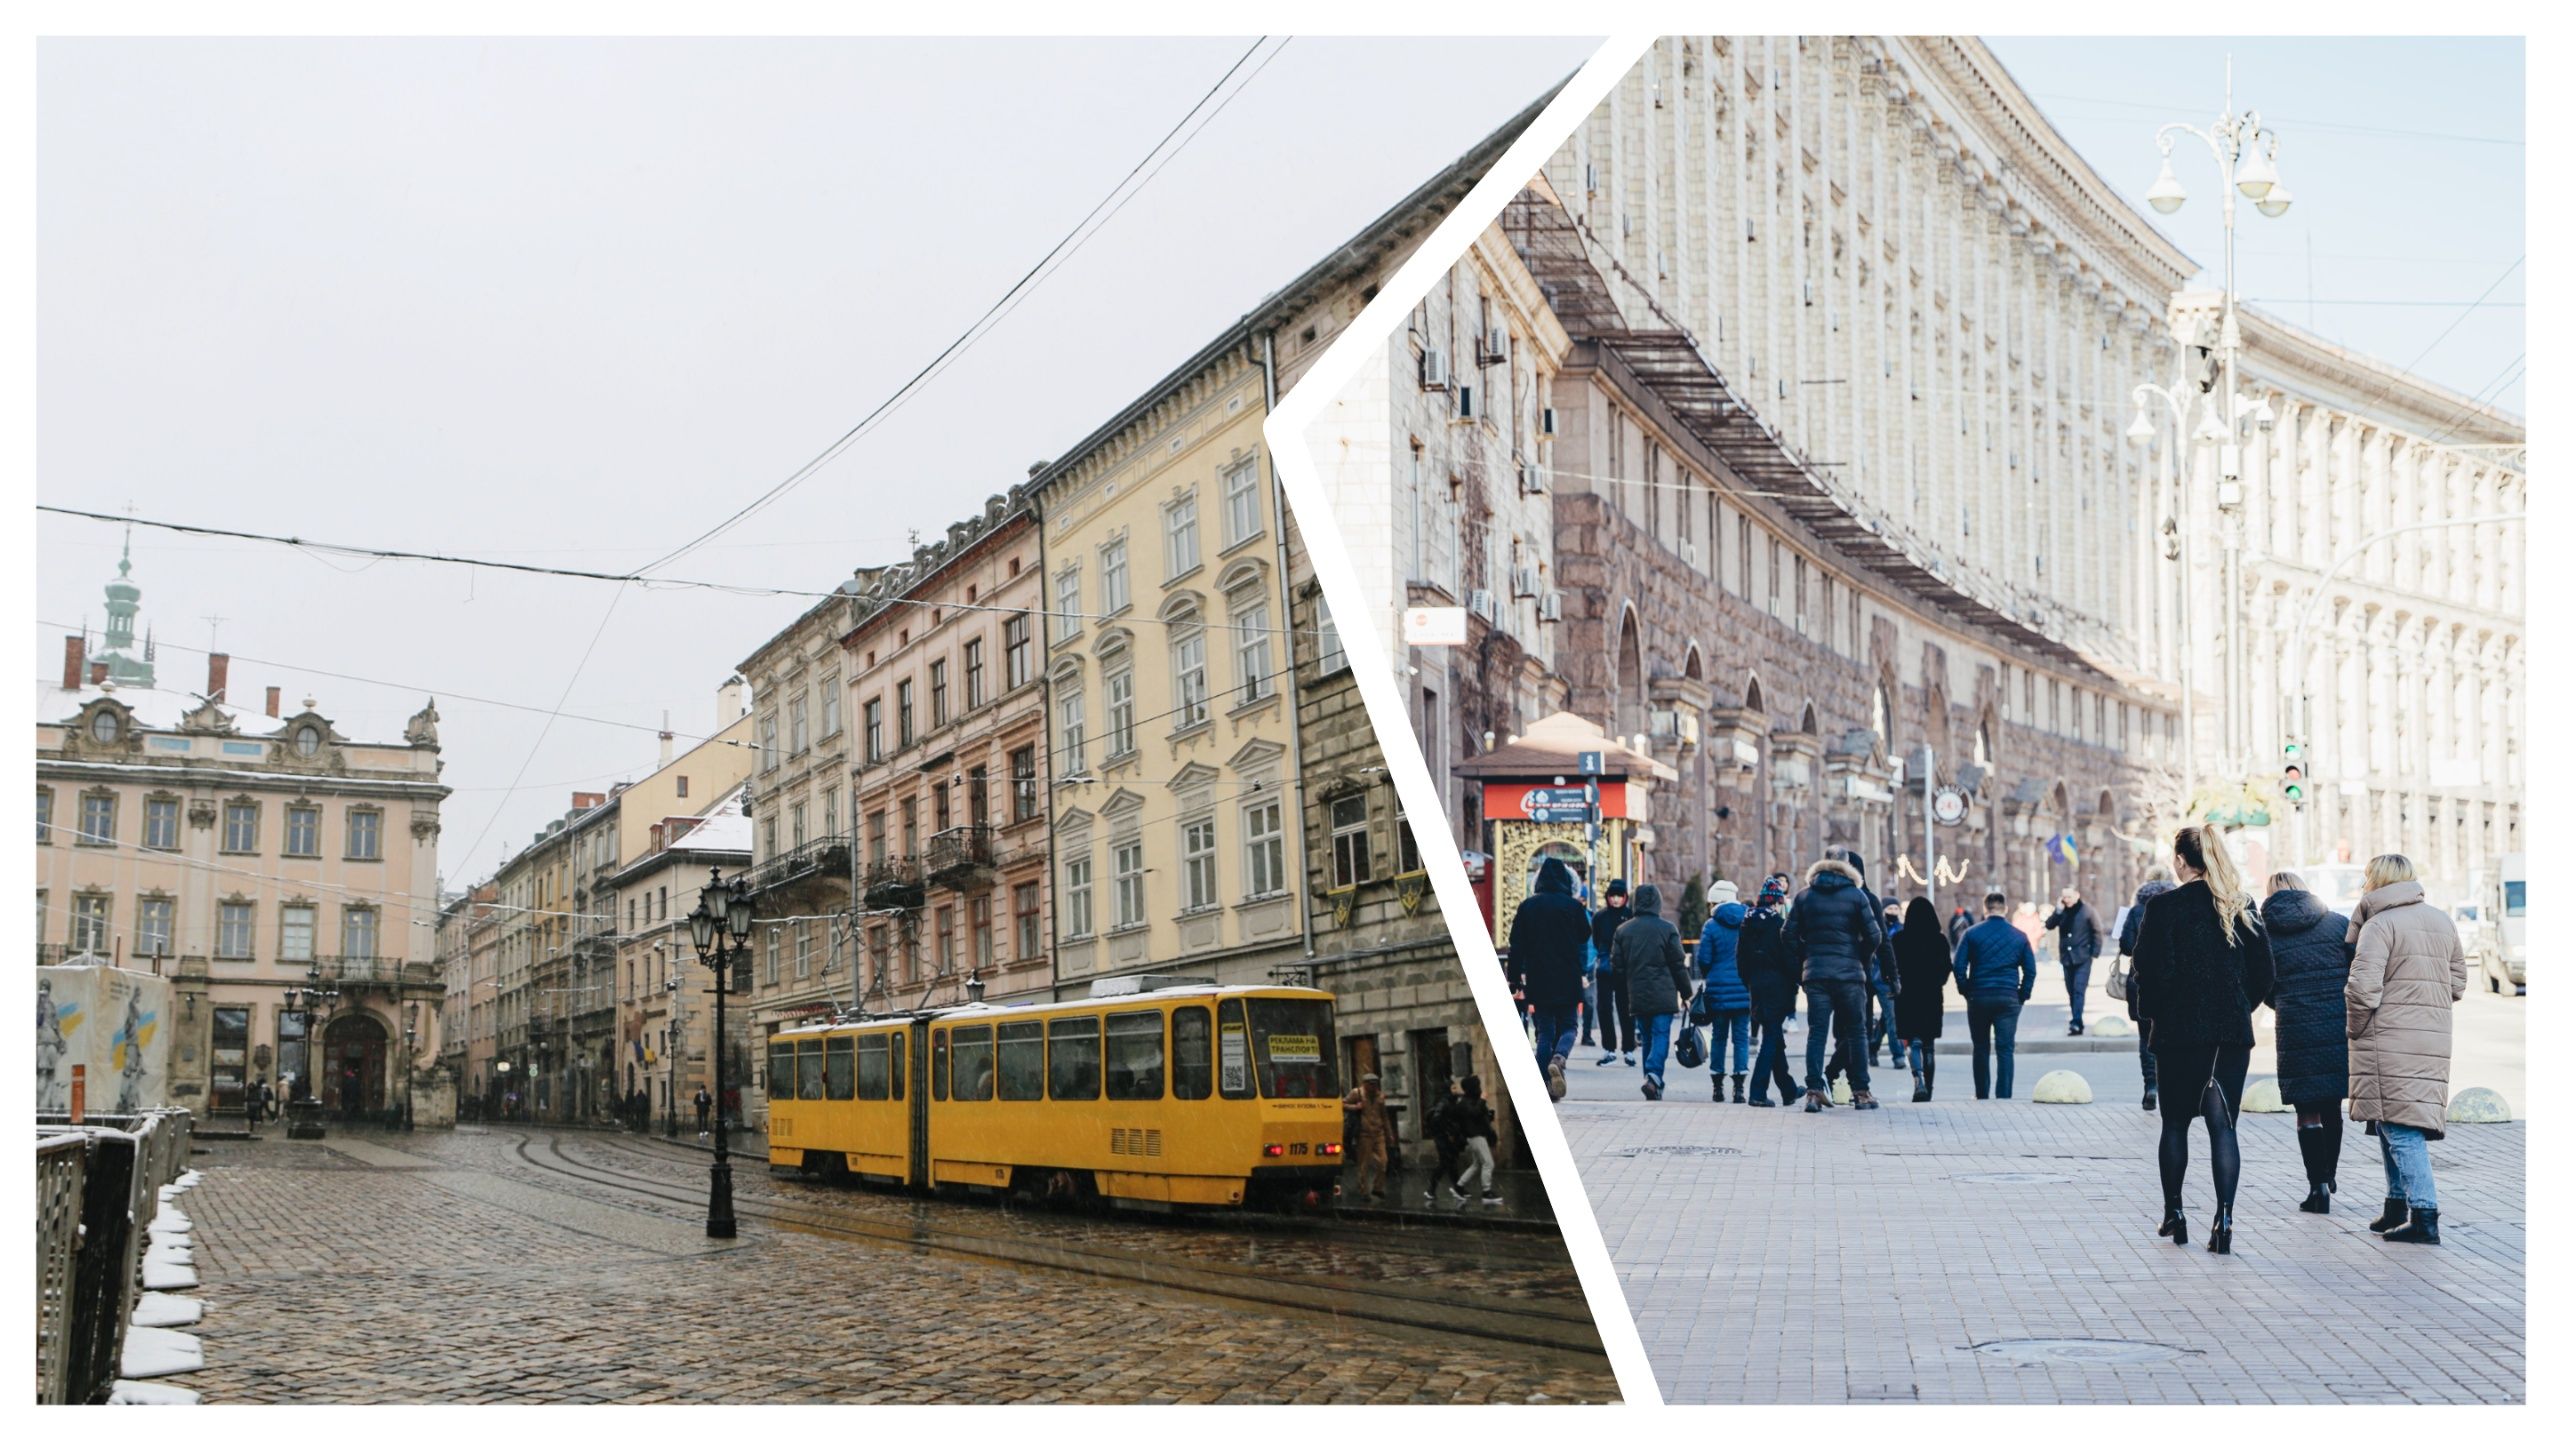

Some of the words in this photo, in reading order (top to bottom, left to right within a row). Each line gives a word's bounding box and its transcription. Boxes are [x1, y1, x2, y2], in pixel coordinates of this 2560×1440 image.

[1270, 1037, 1304, 1045] РЕКЛАМА
[1305, 1037, 1316, 1045] НА
[1290, 1142, 1308, 1155] 1175
